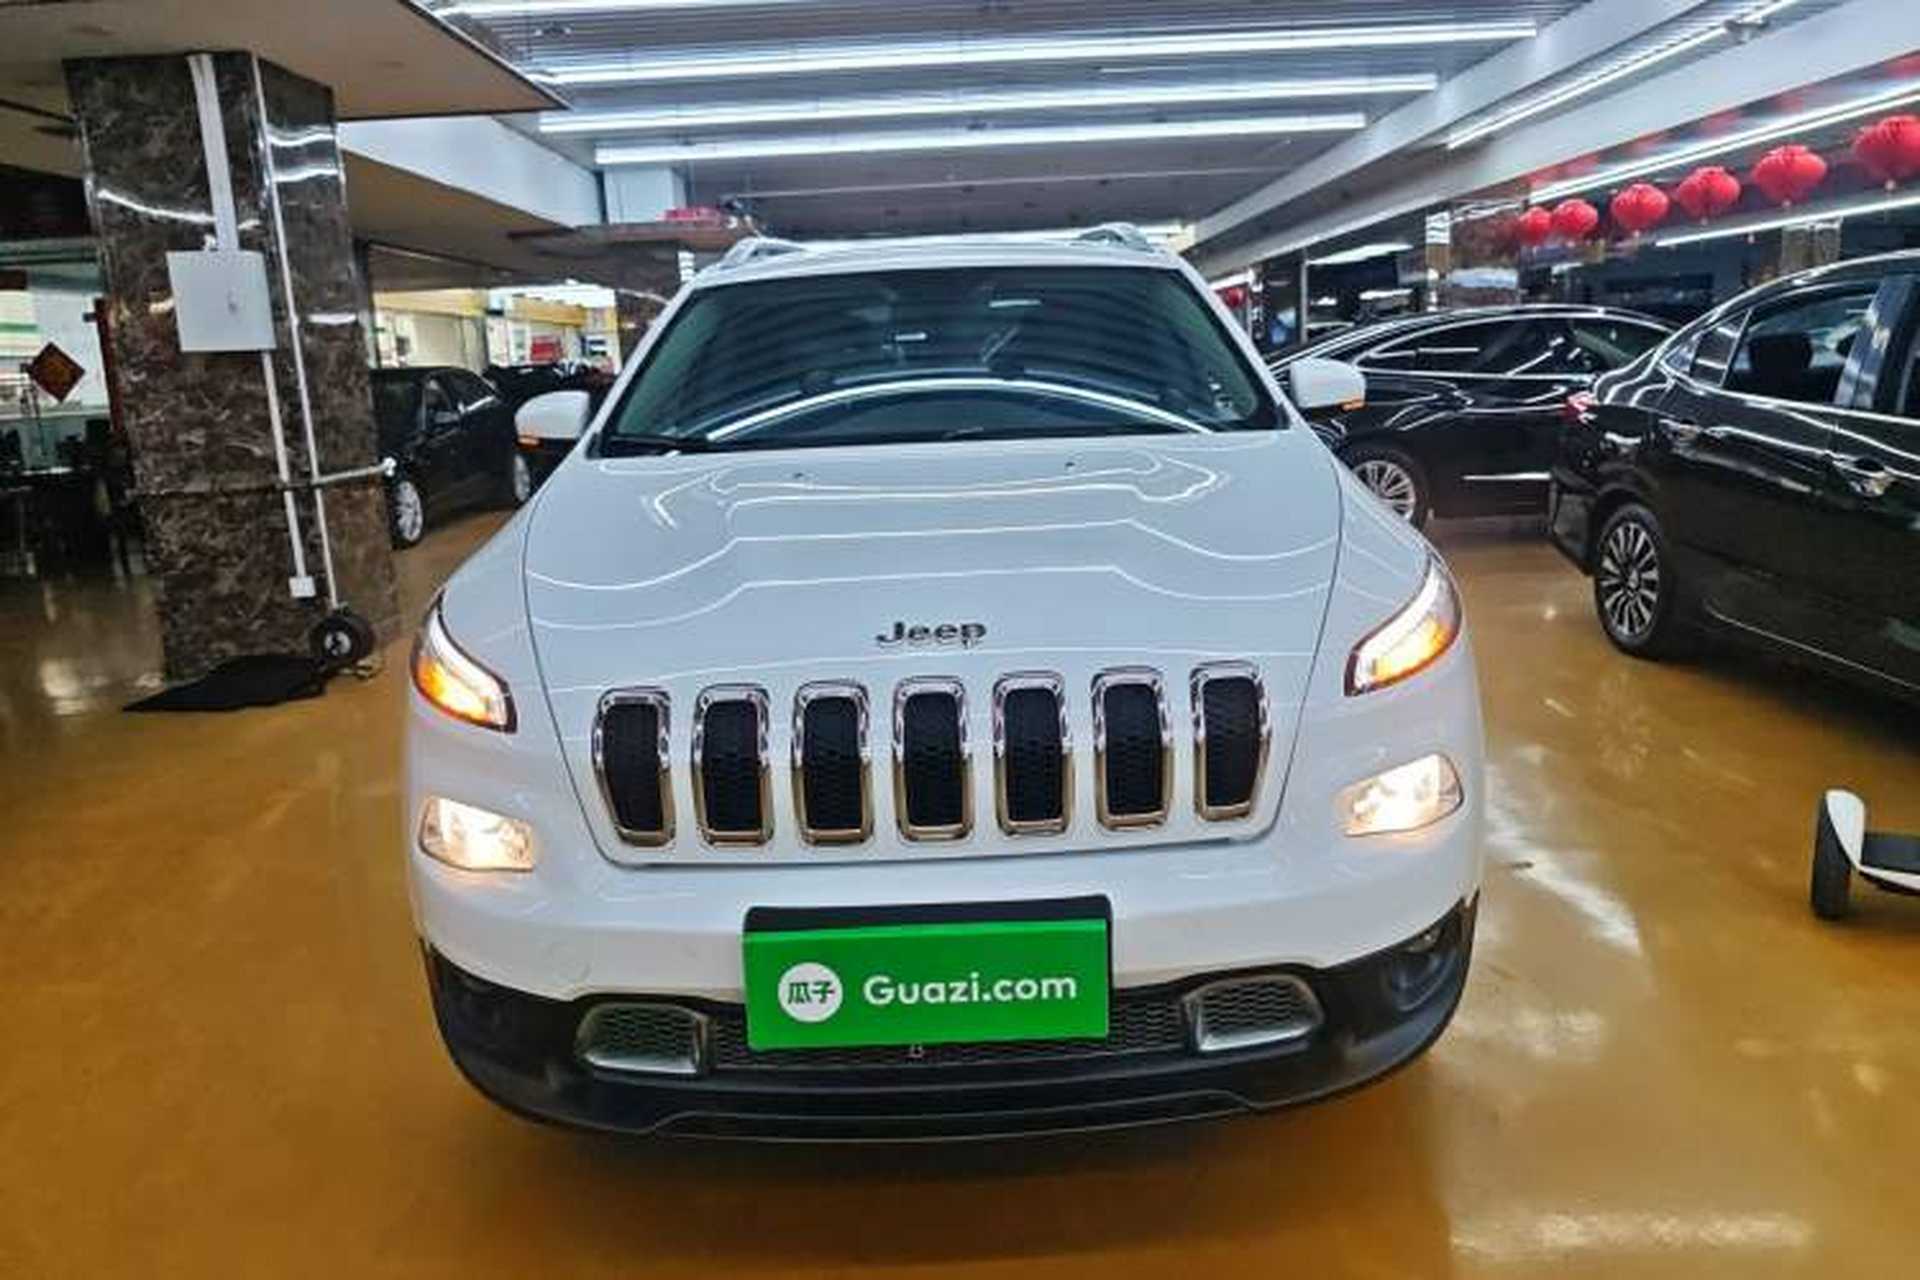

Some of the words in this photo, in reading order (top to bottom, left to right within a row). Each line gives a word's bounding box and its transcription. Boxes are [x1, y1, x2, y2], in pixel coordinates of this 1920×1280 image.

[876, 621, 987, 648] Jeep
[787, 981, 836, 1005] 瓜子
[863, 971, 1077, 1005] Guazi.com
